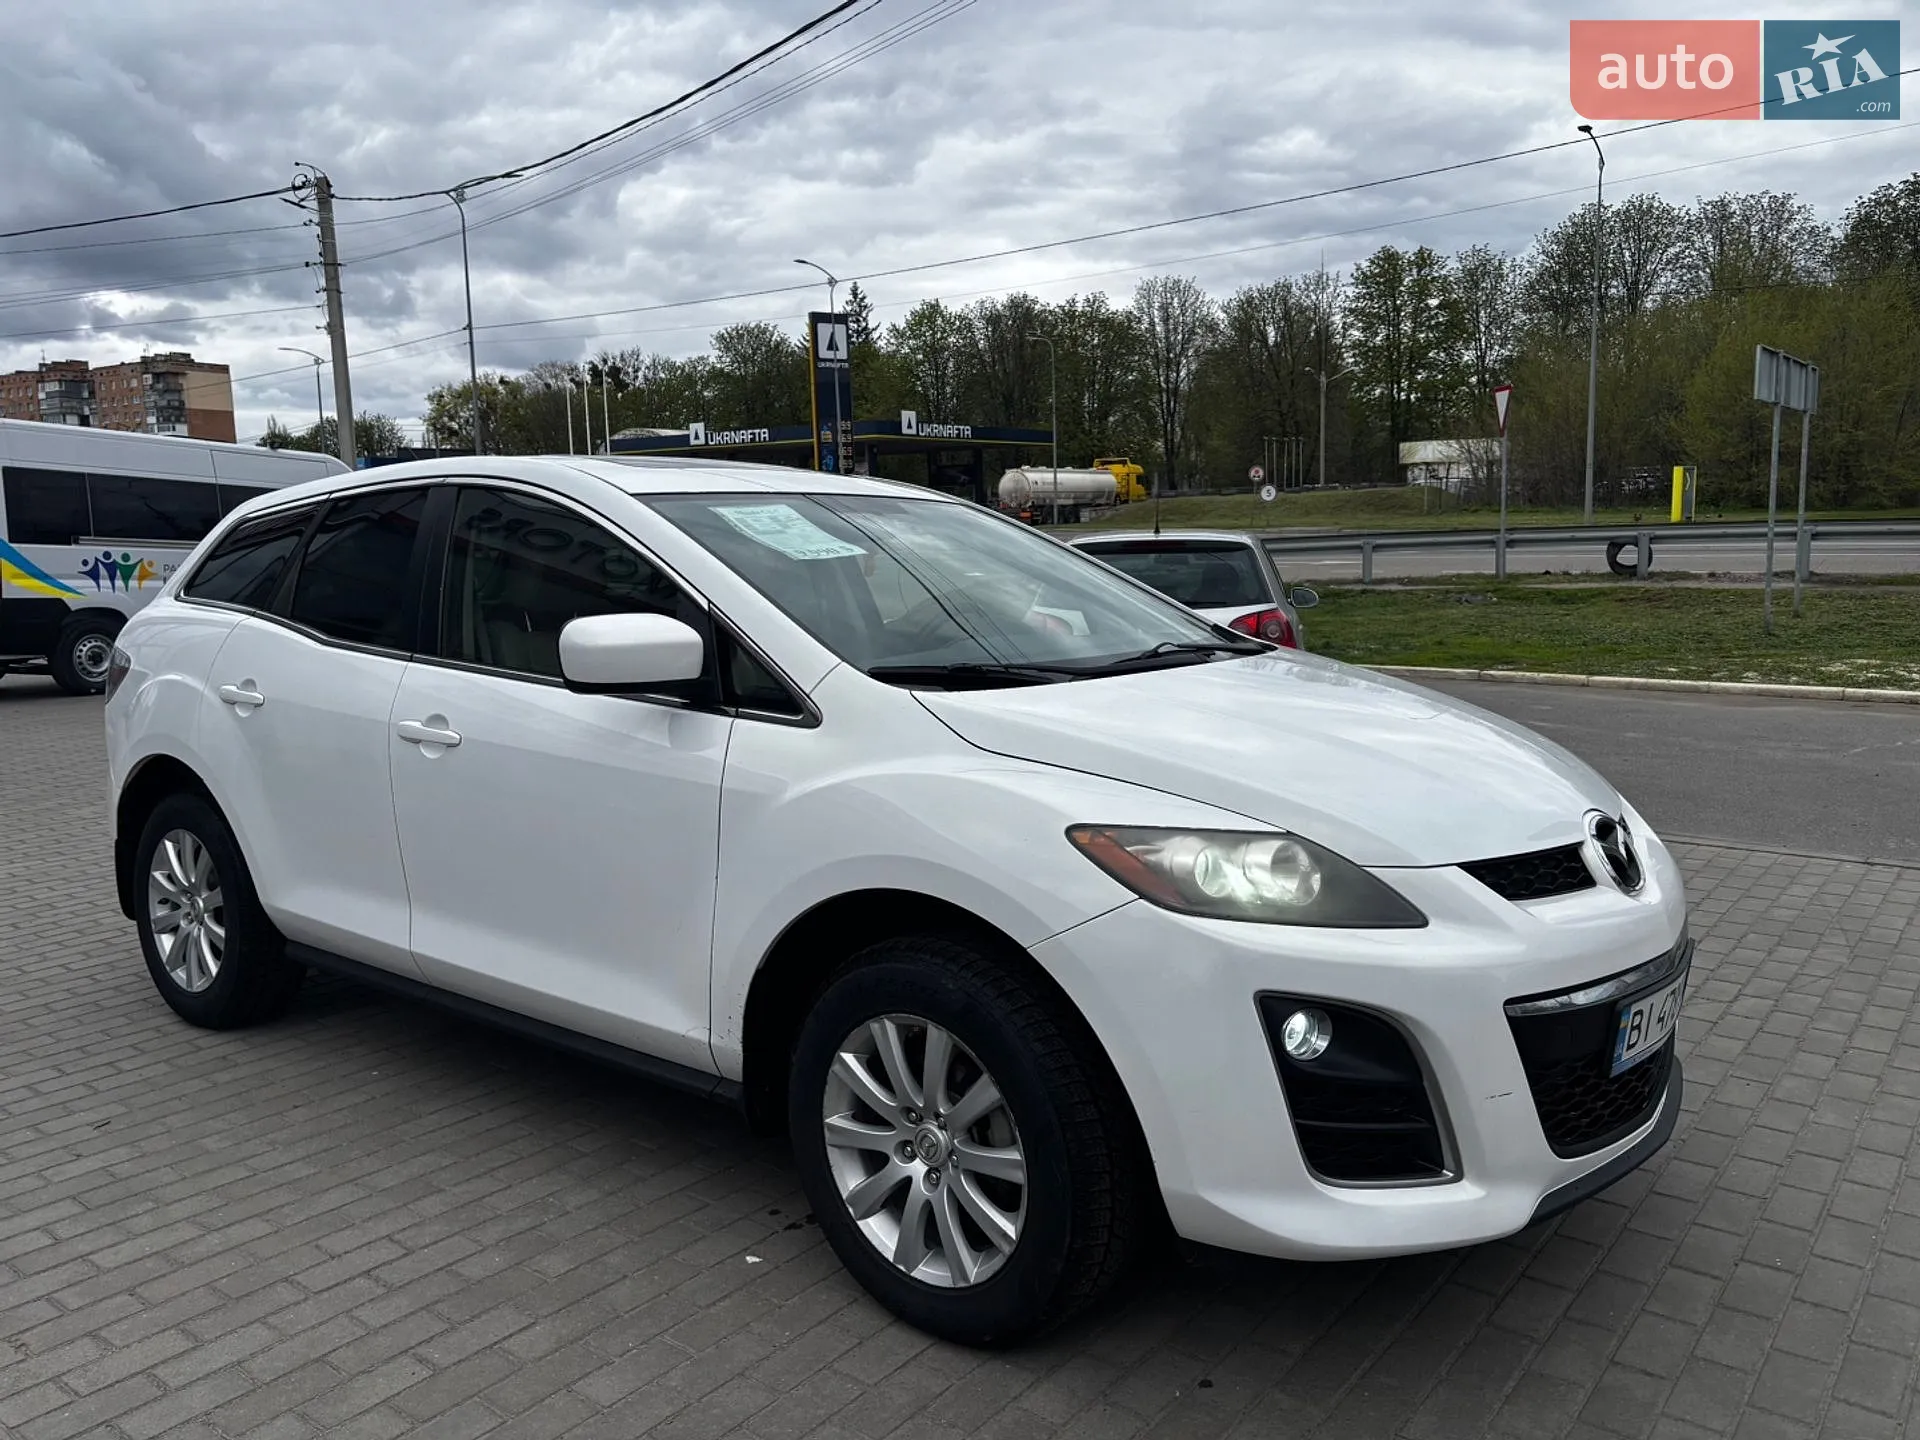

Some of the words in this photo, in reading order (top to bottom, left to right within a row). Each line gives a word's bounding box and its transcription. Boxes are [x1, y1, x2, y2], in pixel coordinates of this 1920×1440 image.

[706, 428, 769, 445] UKRNAFTA
[918, 422, 972, 438] UKRNAFTA
[1626, 1002, 1654, 1052] BI
